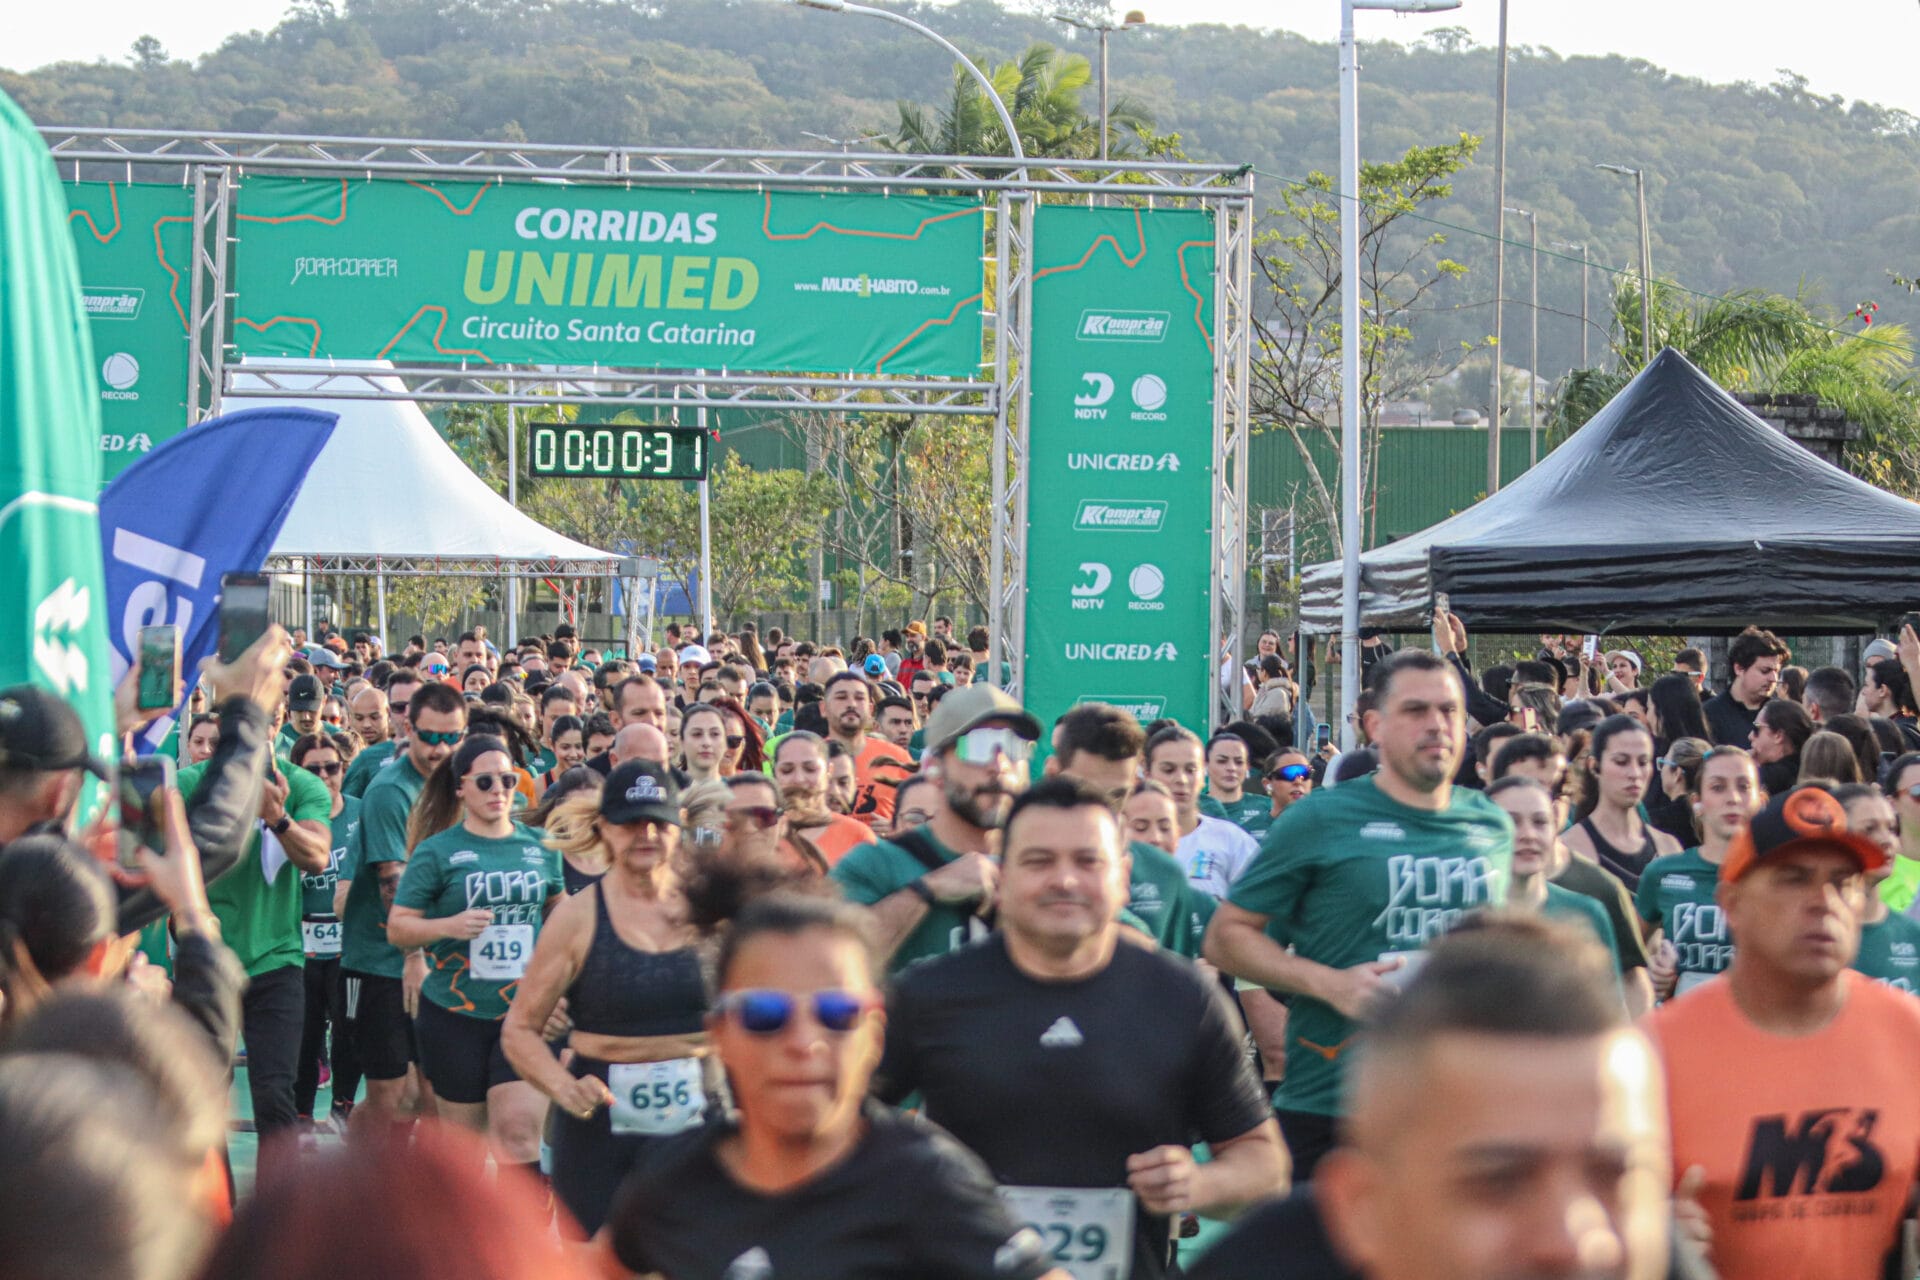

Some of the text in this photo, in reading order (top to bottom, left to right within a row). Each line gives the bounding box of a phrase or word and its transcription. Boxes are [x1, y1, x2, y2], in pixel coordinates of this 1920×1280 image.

[515, 207, 717, 244] CORRIDAS
[463, 250, 760, 311] UNIMED
[462, 316, 756, 346] Circuito Santa Catarina
[101, 390, 140, 401] RECORD
[1074, 408, 1107, 420] NDTV
[1130, 411, 1167, 421] RECORD
[1067, 453, 1154, 471] UNICRED
[1071, 598, 1105, 610] NDTV
[1128, 601, 1165, 611] RECORD
[1065, 643, 1152, 661] UNICRED
[465, 870, 547, 910] BORA
[1372, 853, 1500, 930] BORA
[480, 941, 523, 960] 419
[630, 1079, 690, 1110] 656
